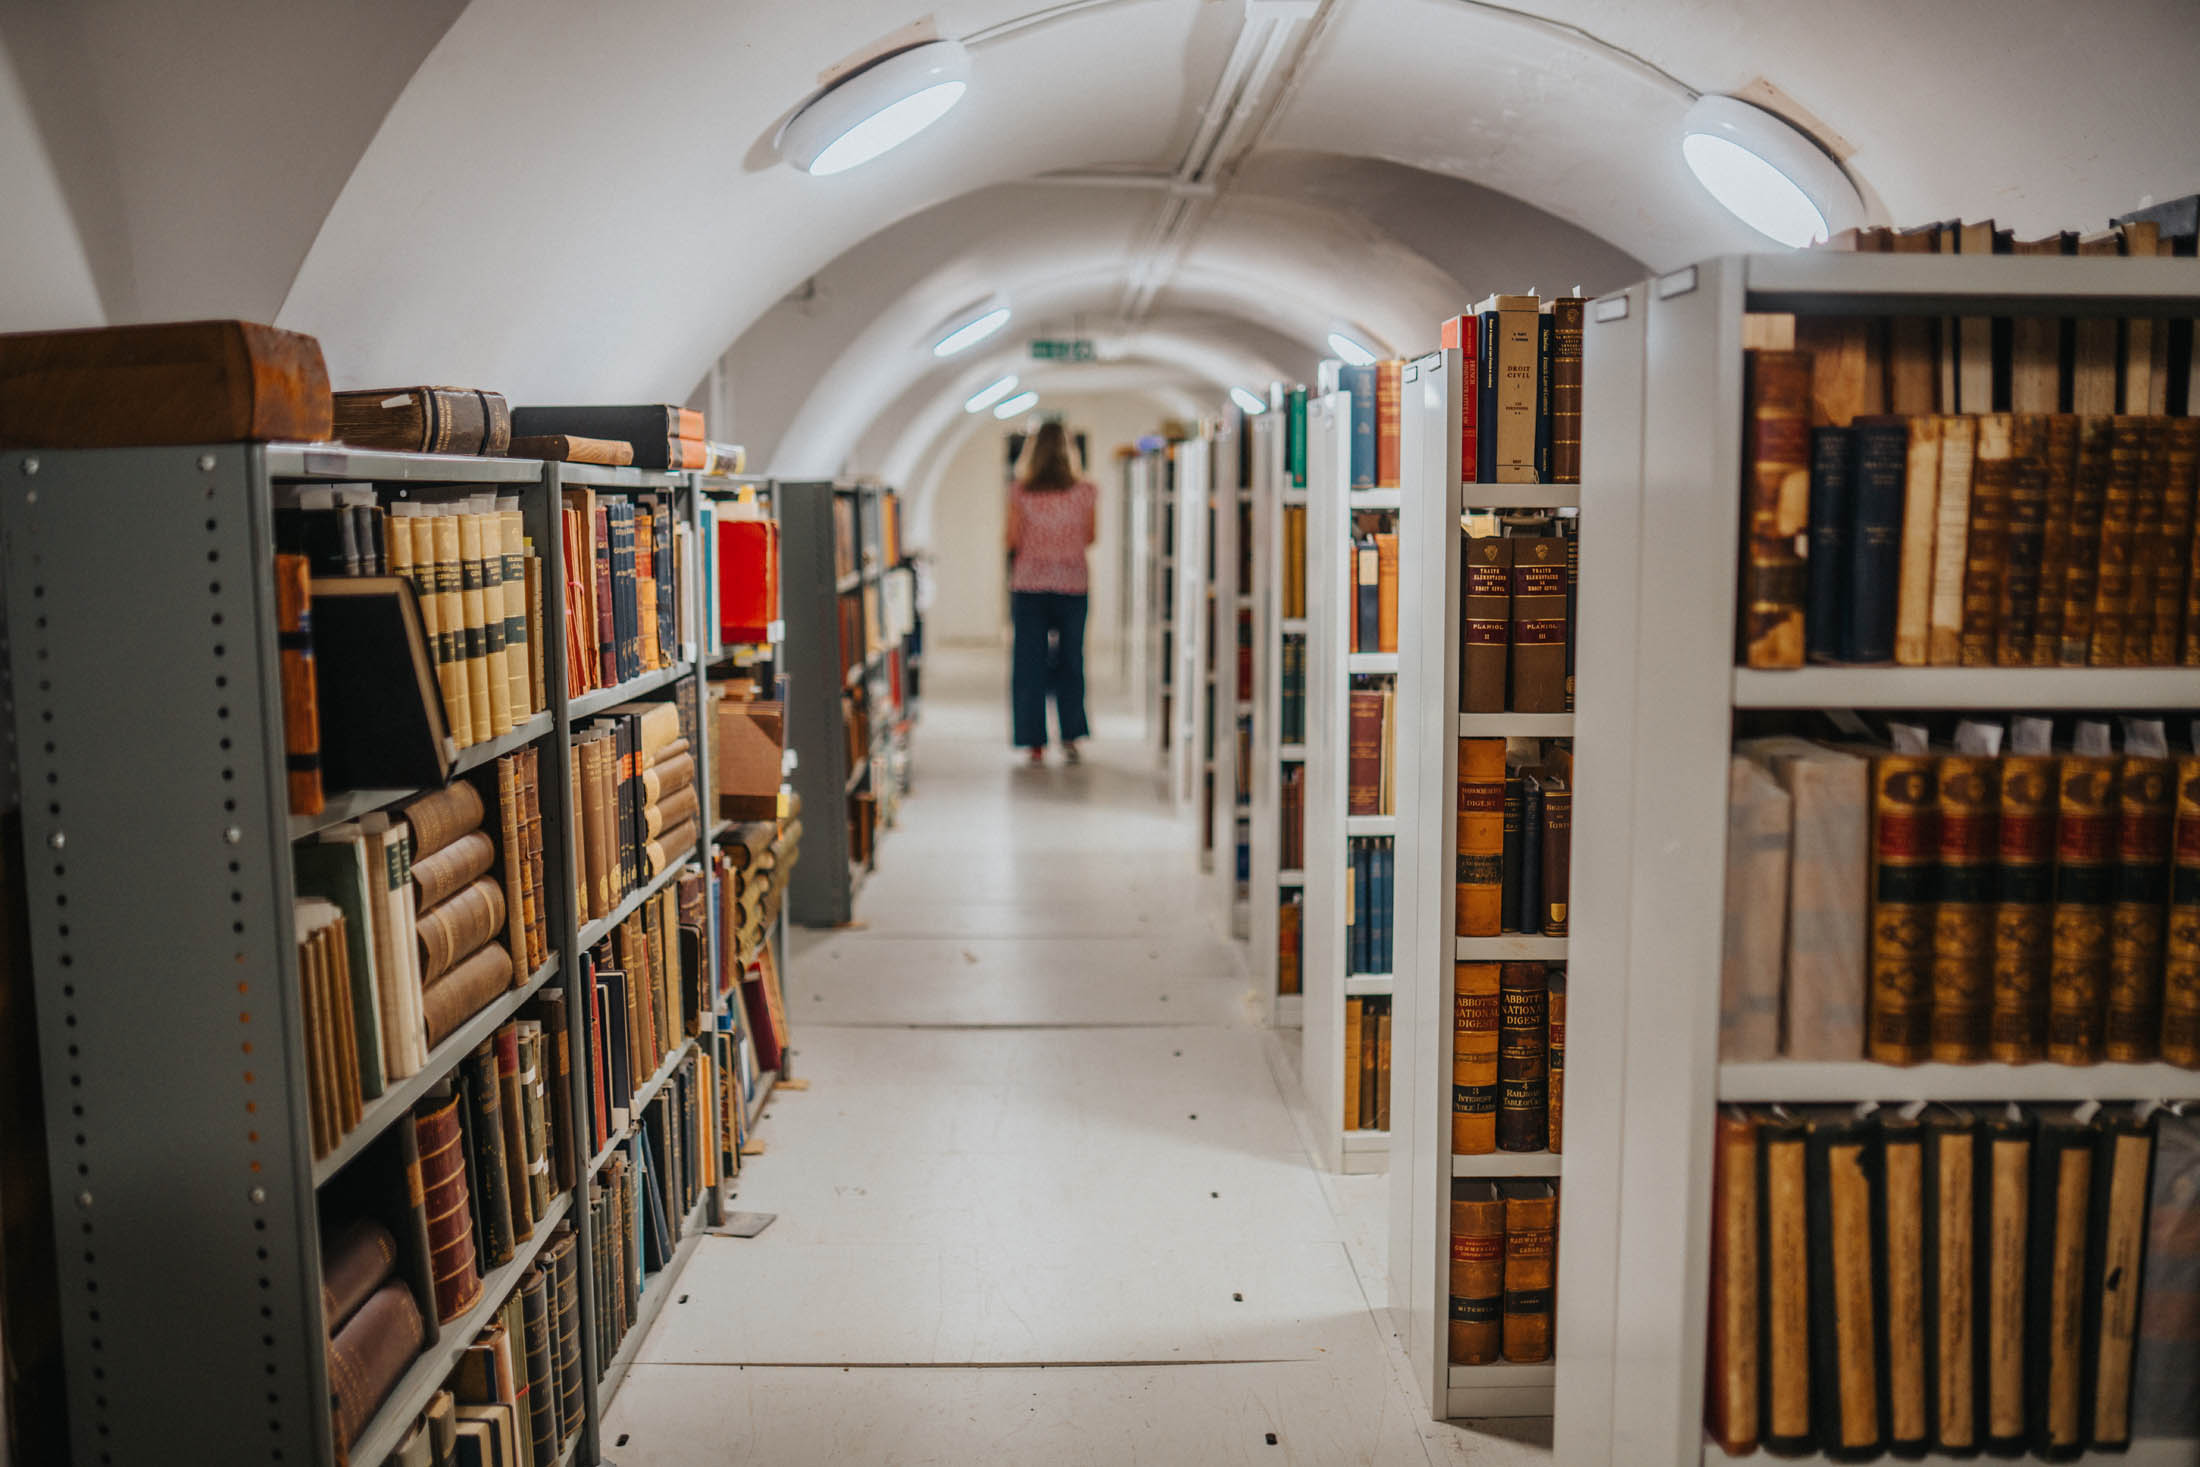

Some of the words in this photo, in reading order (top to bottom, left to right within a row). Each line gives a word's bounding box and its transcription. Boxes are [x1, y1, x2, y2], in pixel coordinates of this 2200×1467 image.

[1458, 1019, 1496, 1028] DIGEST
[1507, 1016, 1540, 1024] DIGEST
[1522, 1082, 1528, 1090] 4
